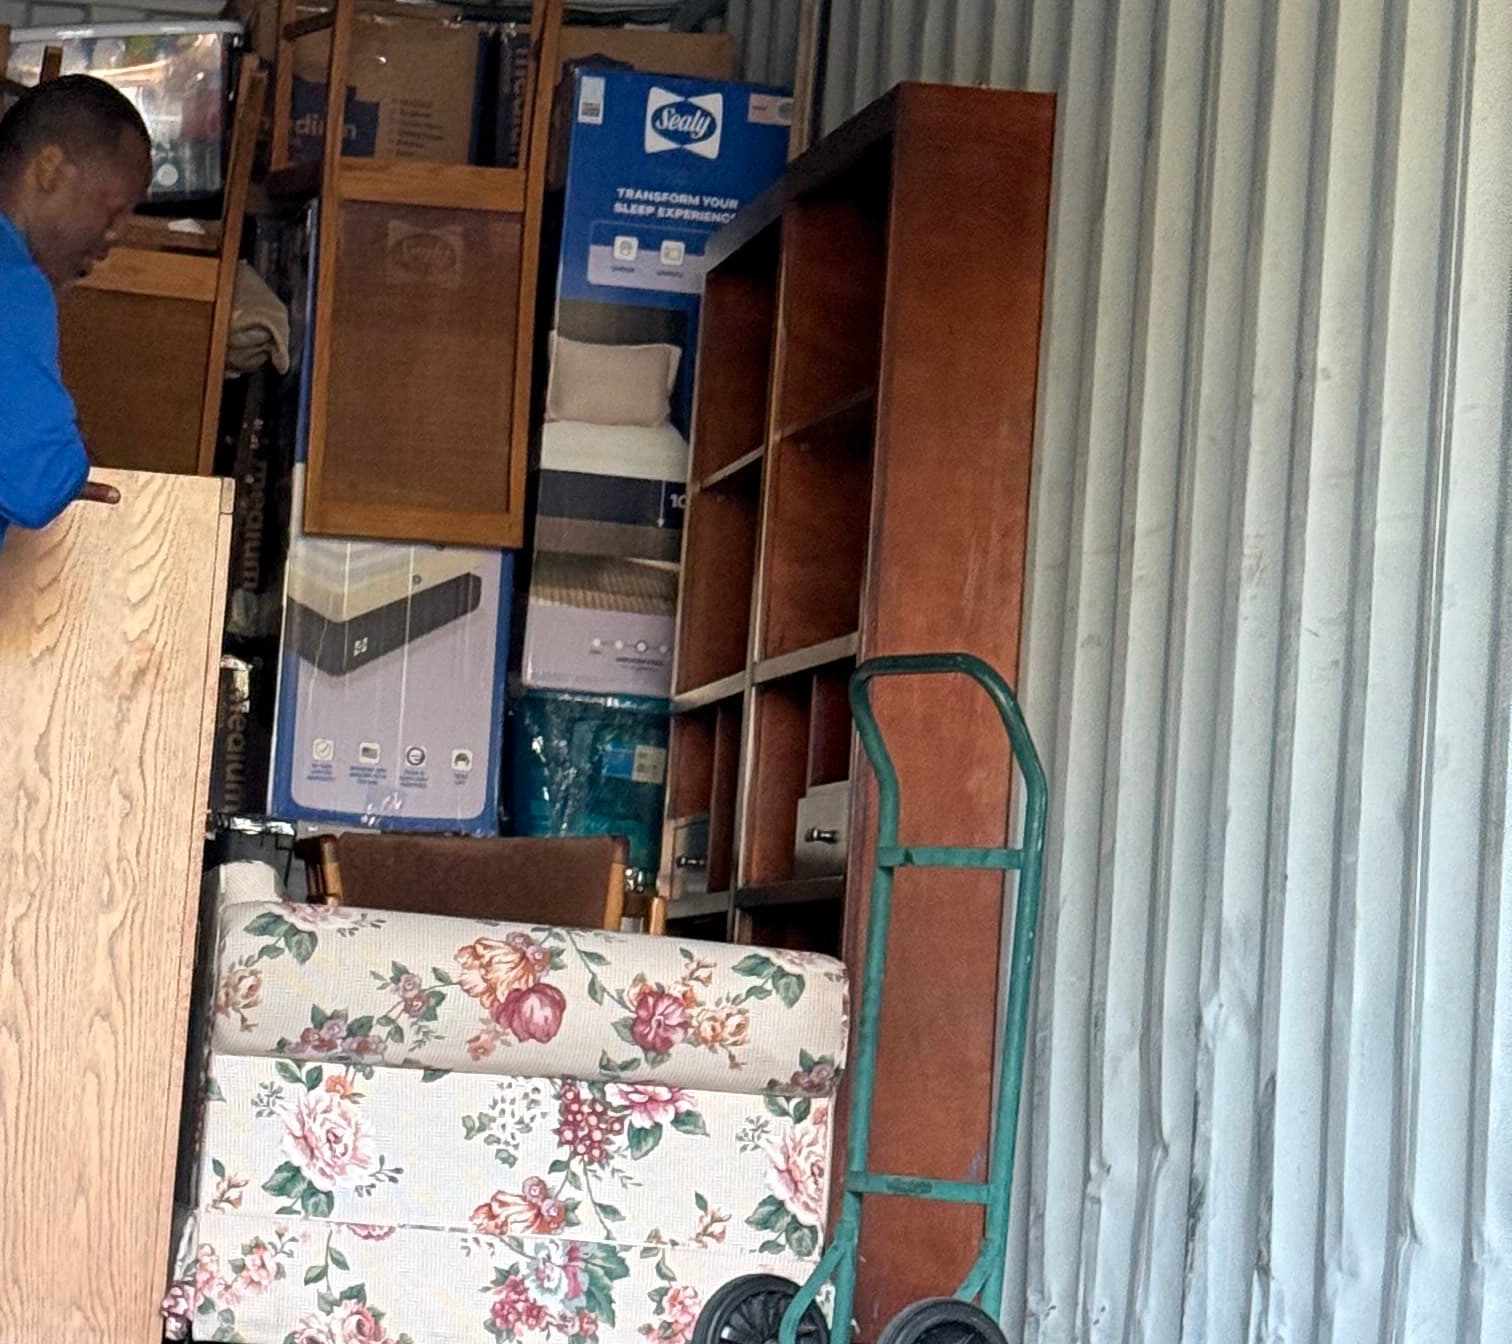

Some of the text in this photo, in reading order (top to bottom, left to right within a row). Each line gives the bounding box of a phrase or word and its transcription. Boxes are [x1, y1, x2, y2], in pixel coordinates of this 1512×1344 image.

[655, 106, 712, 140] Sealy
[616, 187, 739, 210] TRANSFORM YOUR
[613, 202, 736, 224] SLEEP EXPERIENC
